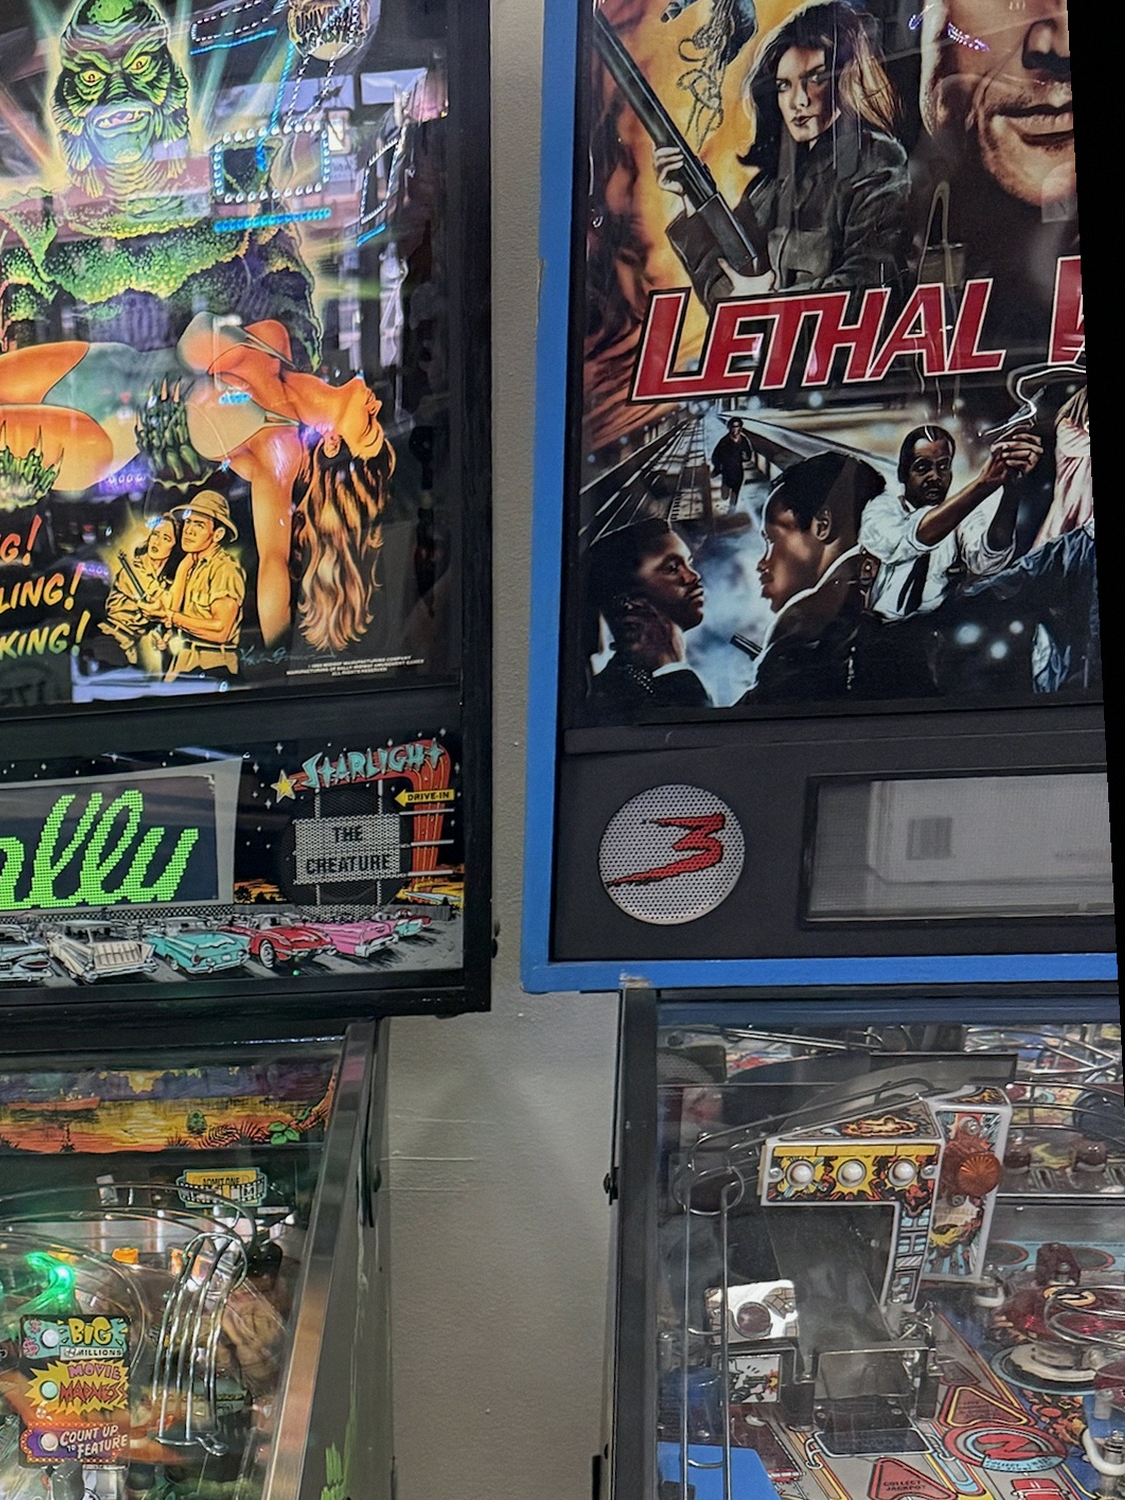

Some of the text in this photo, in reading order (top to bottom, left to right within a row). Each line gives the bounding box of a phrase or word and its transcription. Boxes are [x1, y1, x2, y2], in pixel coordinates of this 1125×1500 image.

[631, 278, 1007, 402] LETHAL
[301, 738, 445, 789] STARLIGHT
[406, 790, 450, 802] DRIVE-IN
[332, 825, 364, 843] THE
[605, 811, 726, 888] 3
[305, 853, 392, 876] CREATURE
[68, 1316, 114, 1346] BIG
[68, 1363, 123, 1381] MOVIE
[59, 1380, 129, 1404] MADNESS
[60, 1424, 119, 1447] COUNT UP
[77, 1434, 128, 1459] FEATURE
